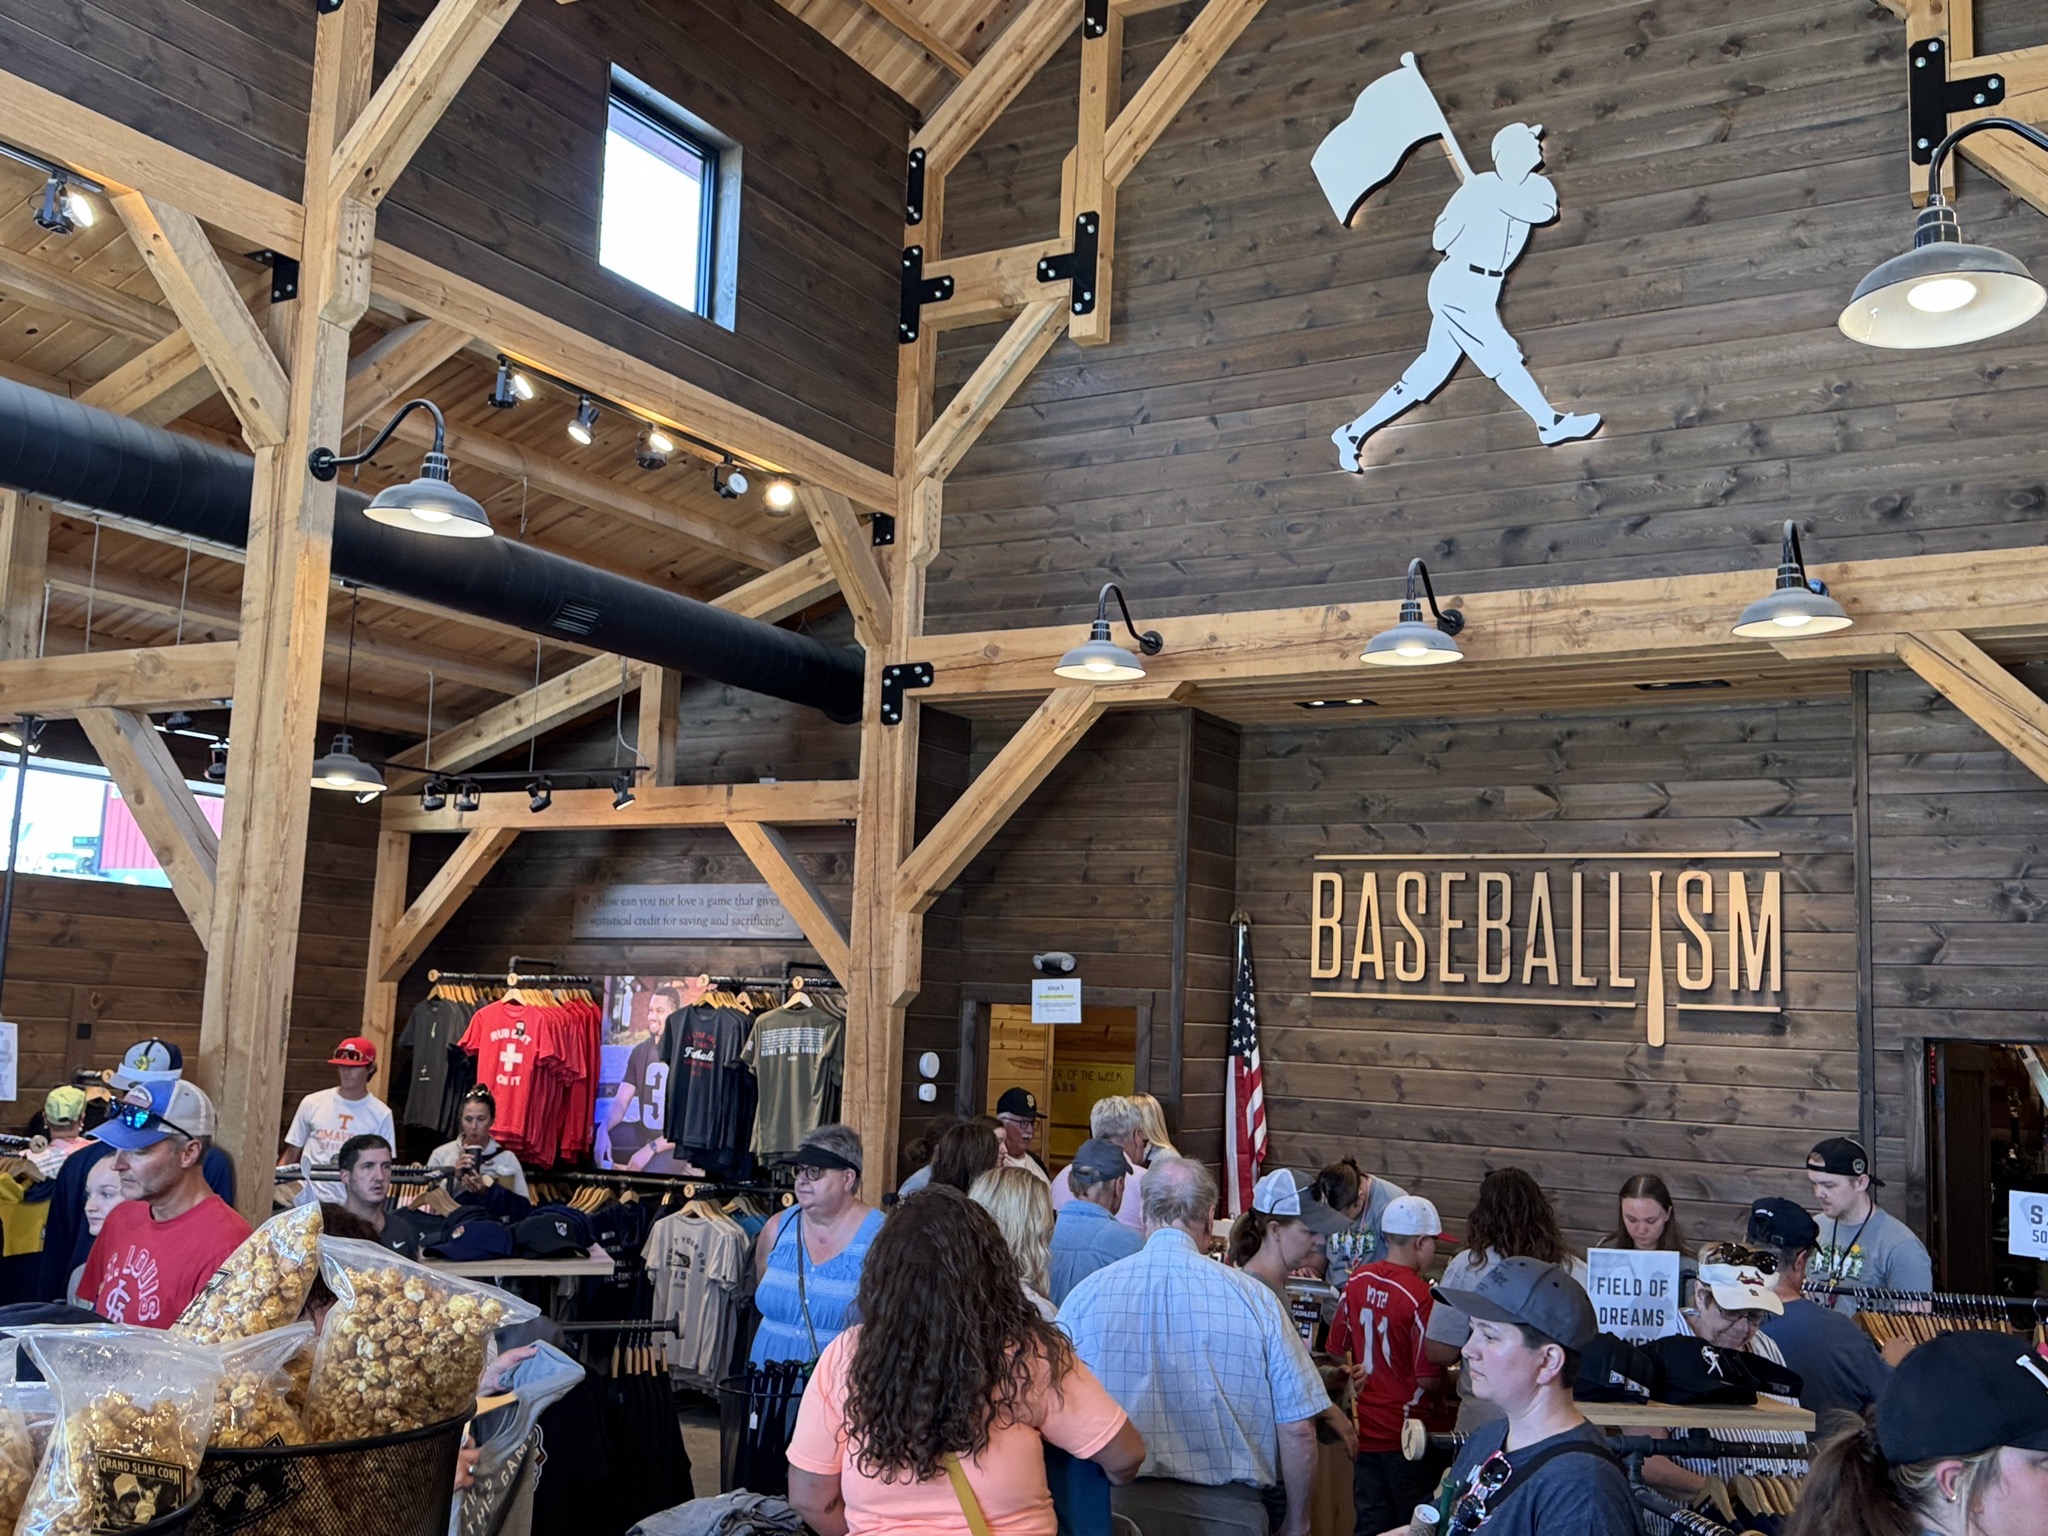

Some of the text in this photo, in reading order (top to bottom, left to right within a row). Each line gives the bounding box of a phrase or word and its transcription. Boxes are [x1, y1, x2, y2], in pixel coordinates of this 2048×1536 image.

[639, 899, 656, 909] you
[658, 898, 675, 906] not
[677, 894, 696, 906] love
[706, 898, 732, 908] game
[734, 893, 755, 906] that
[756, 897, 781, 909] gives
[634, 914, 660, 926] credit
[662, 914, 677, 926] for
[679, 917, 708, 928] saving
[710, 914, 729, 926] and
[731, 914, 785, 928] sacrificing?
[1310, 870, 1782, 1047] BASEBALLISM
[123, 1245, 160, 1322] LOUIS
[1597, 1276, 1669, 1297] FIELD OF
[1599, 1307, 1665, 1327] DREAMS
[99, 1456, 180, 1485] GRAND SLAM CORN
[204, 1465, 243, 1490] REAM
